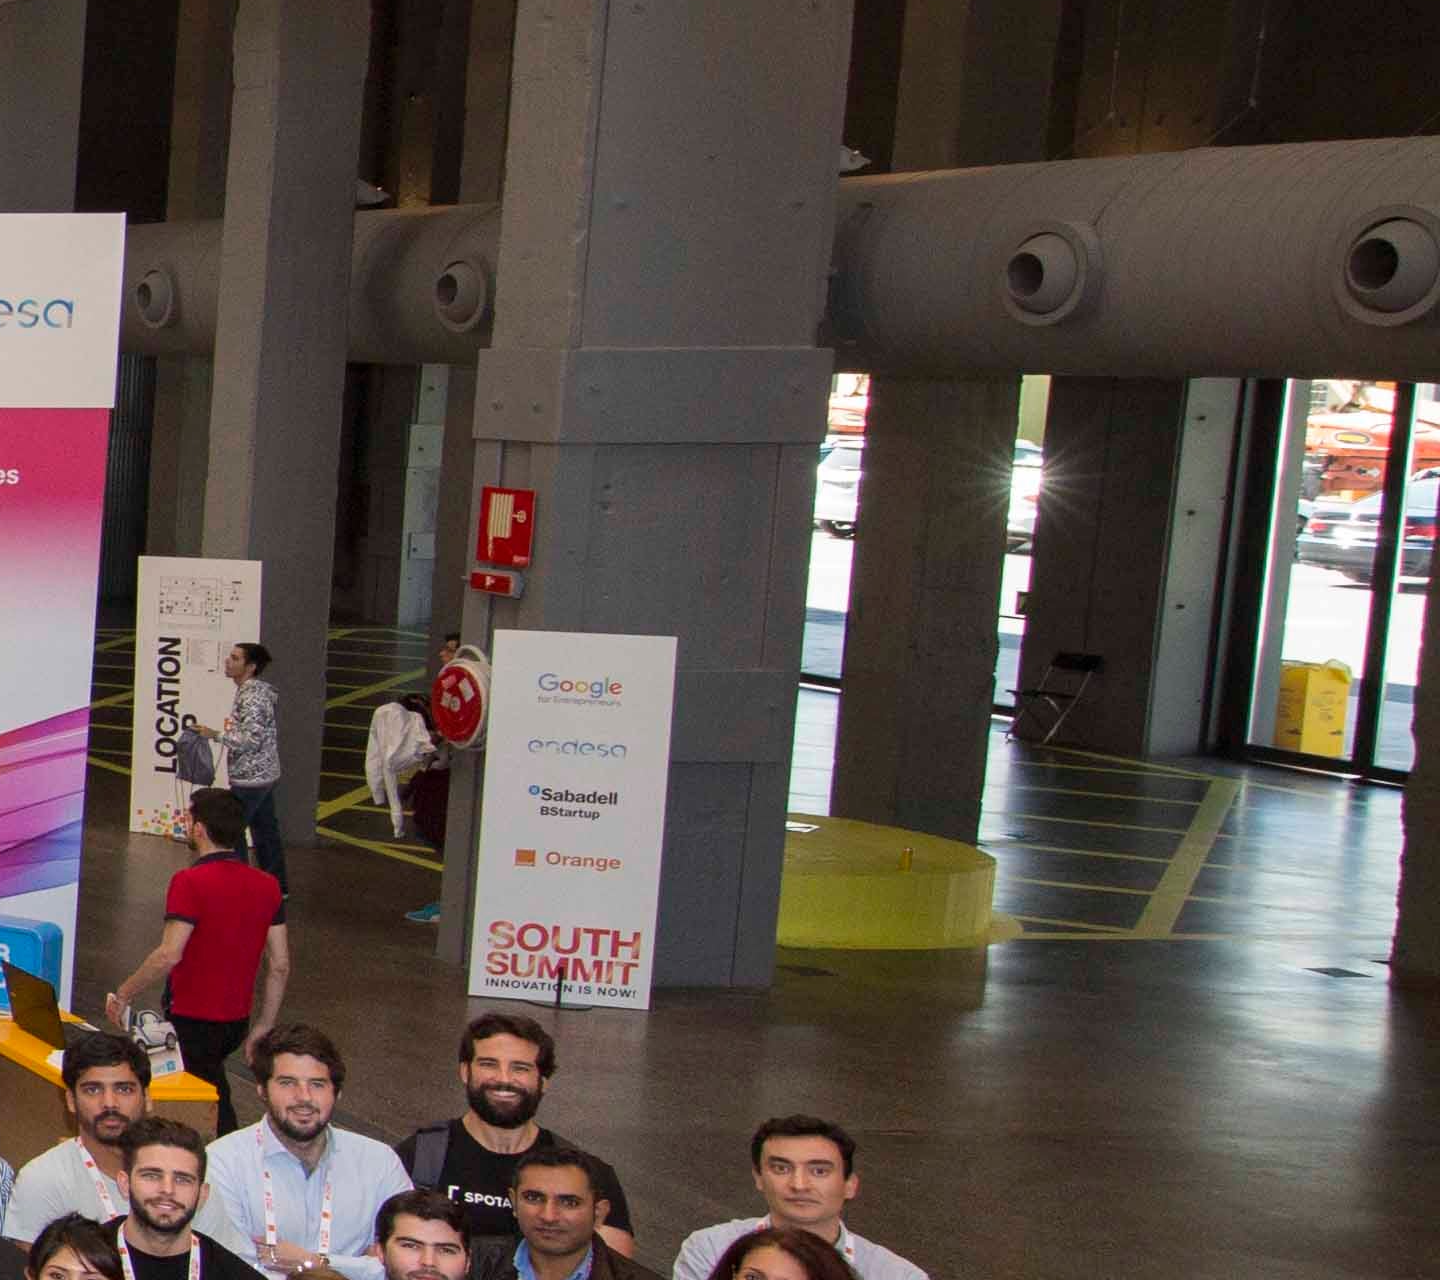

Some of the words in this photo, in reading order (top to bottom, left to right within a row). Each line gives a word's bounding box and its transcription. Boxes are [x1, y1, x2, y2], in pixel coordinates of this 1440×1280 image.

[538, 673, 622, 699] Google
[154, 636, 182, 773] LOCATION
[528, 738, 626, 759] endesa
[541, 787, 618, 805] Sabadell
[540, 806, 600, 820] BStartup
[546, 851, 621, 871] Orange
[487, 920, 642, 959] SOUTH
[485, 951, 640, 986] SUMMIT
[578, 984, 592, 995] IS
[597, 985, 637, 999] NOW!
